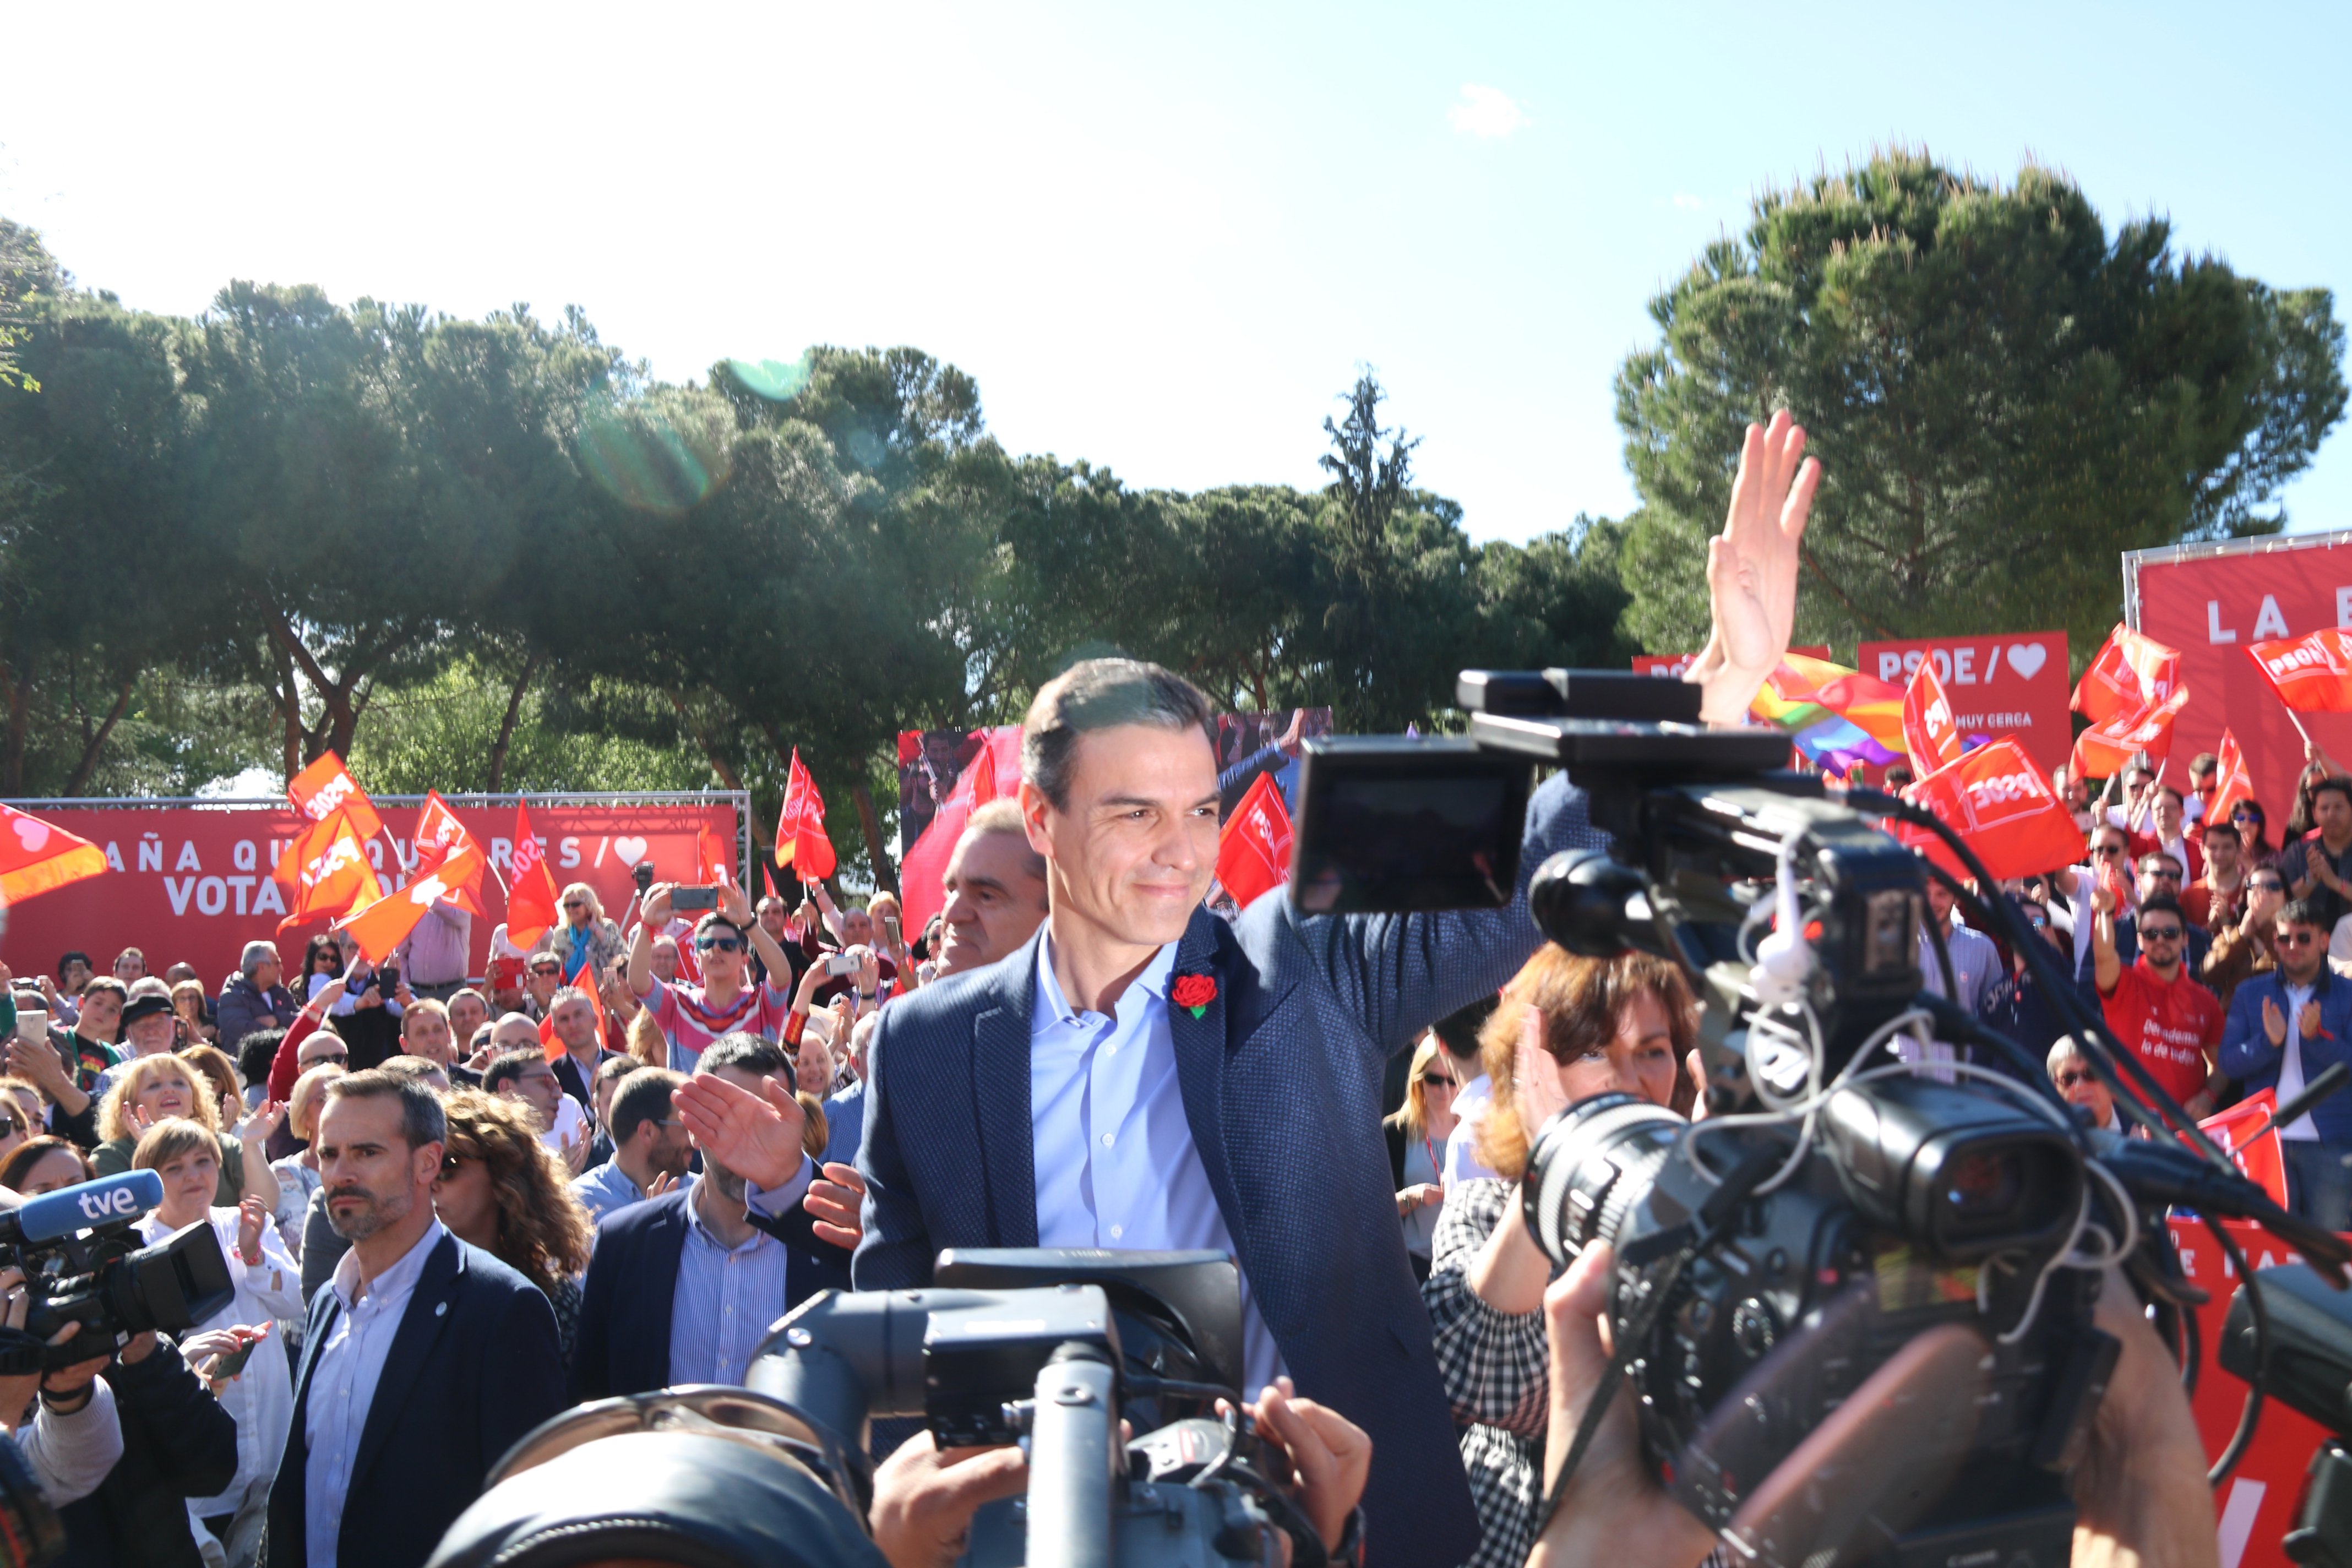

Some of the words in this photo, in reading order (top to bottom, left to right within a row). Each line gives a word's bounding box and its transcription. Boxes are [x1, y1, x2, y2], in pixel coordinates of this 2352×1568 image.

[2208, 594, 2289, 645] LA
[1956, 714, 1984, 729] MUY
[1988, 712, 2032, 727] CERCA
[105, 832, 202, 872] AÑA
[164, 875, 287, 916] VOTA
[78, 1187, 138, 1219] tve
